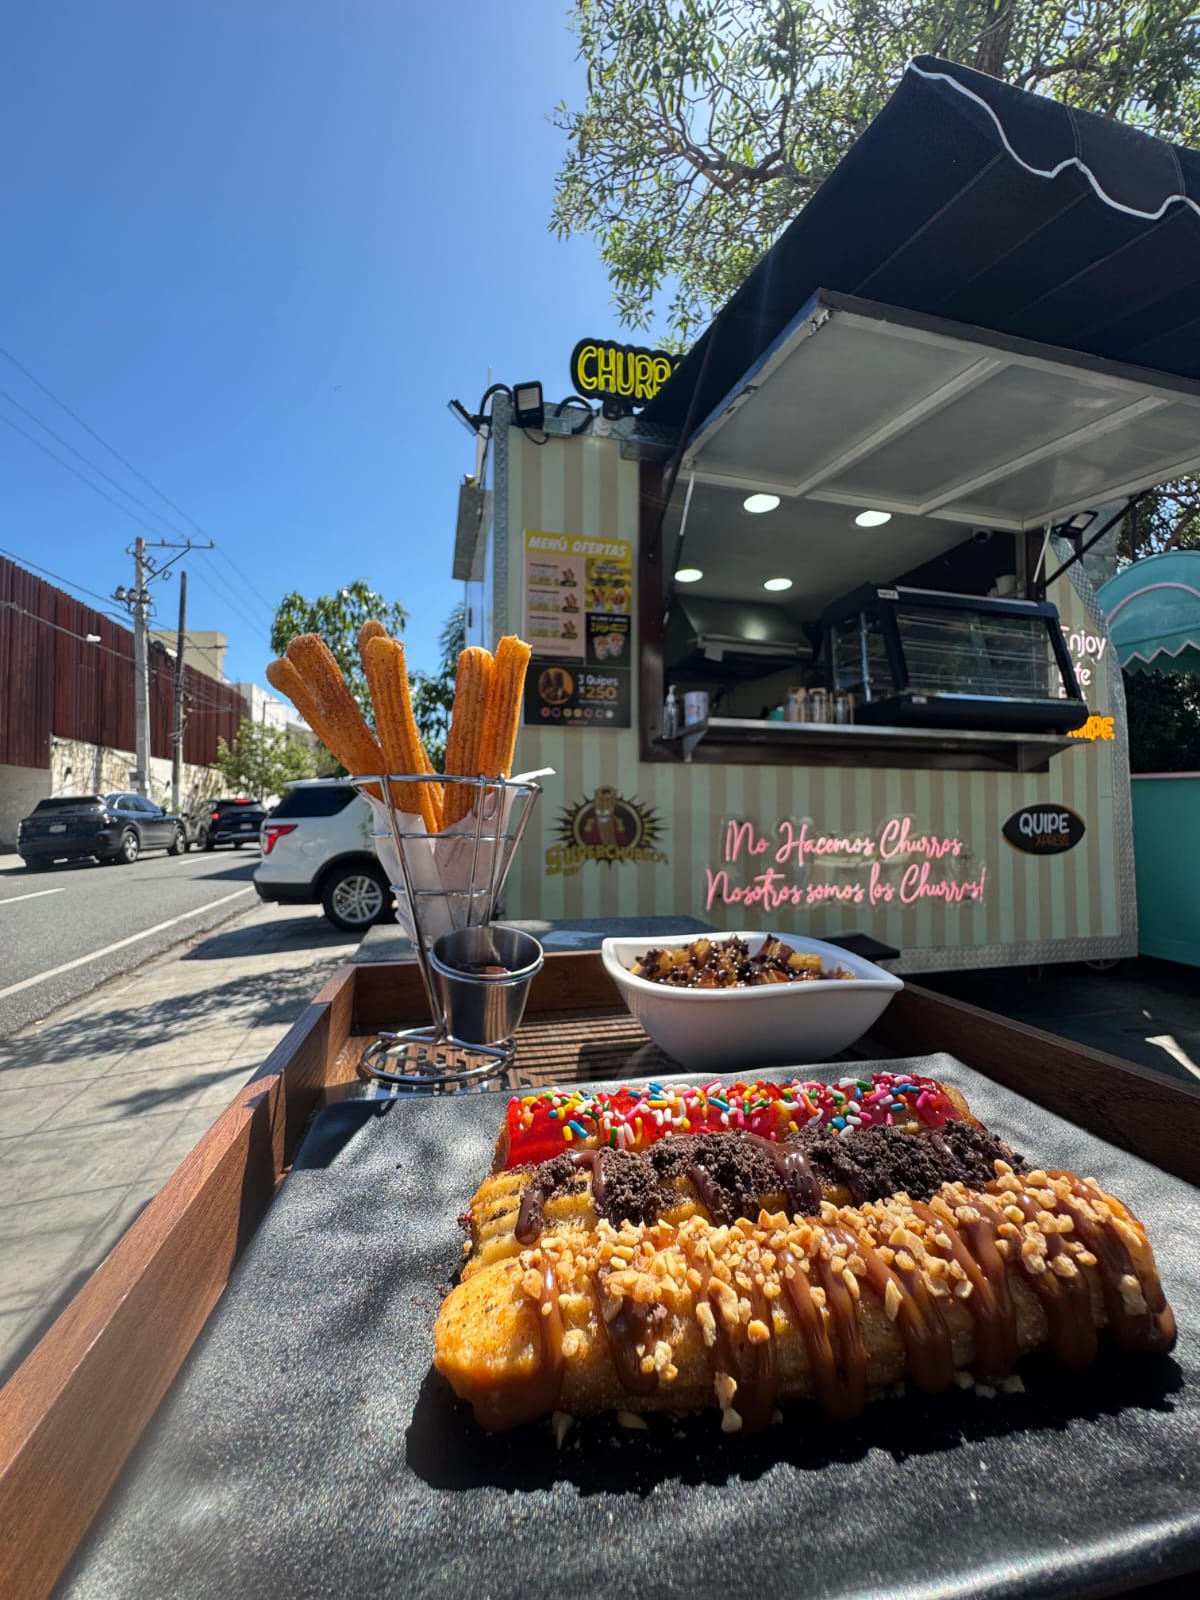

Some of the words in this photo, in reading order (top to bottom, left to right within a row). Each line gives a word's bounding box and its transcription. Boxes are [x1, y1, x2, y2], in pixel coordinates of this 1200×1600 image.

[577, 345, 681, 399] CHURR
[528, 536, 568, 552] MENÚ
[572, 540, 627, 557] OFERTAS
[577, 673, 585, 685] 3
[586, 674, 619, 687] Quipes
[586, 686, 617, 700] 250
[1019, 812, 1070, 837] QUIPE
[775, 821, 875, 867] Hacemos
[880, 817, 963, 858] Churros
[1036, 835, 1069, 847] XPRESS
[706, 867, 804, 912] Nosotros
[806, 883, 865, 904] somos
[870, 862, 895, 905] los
